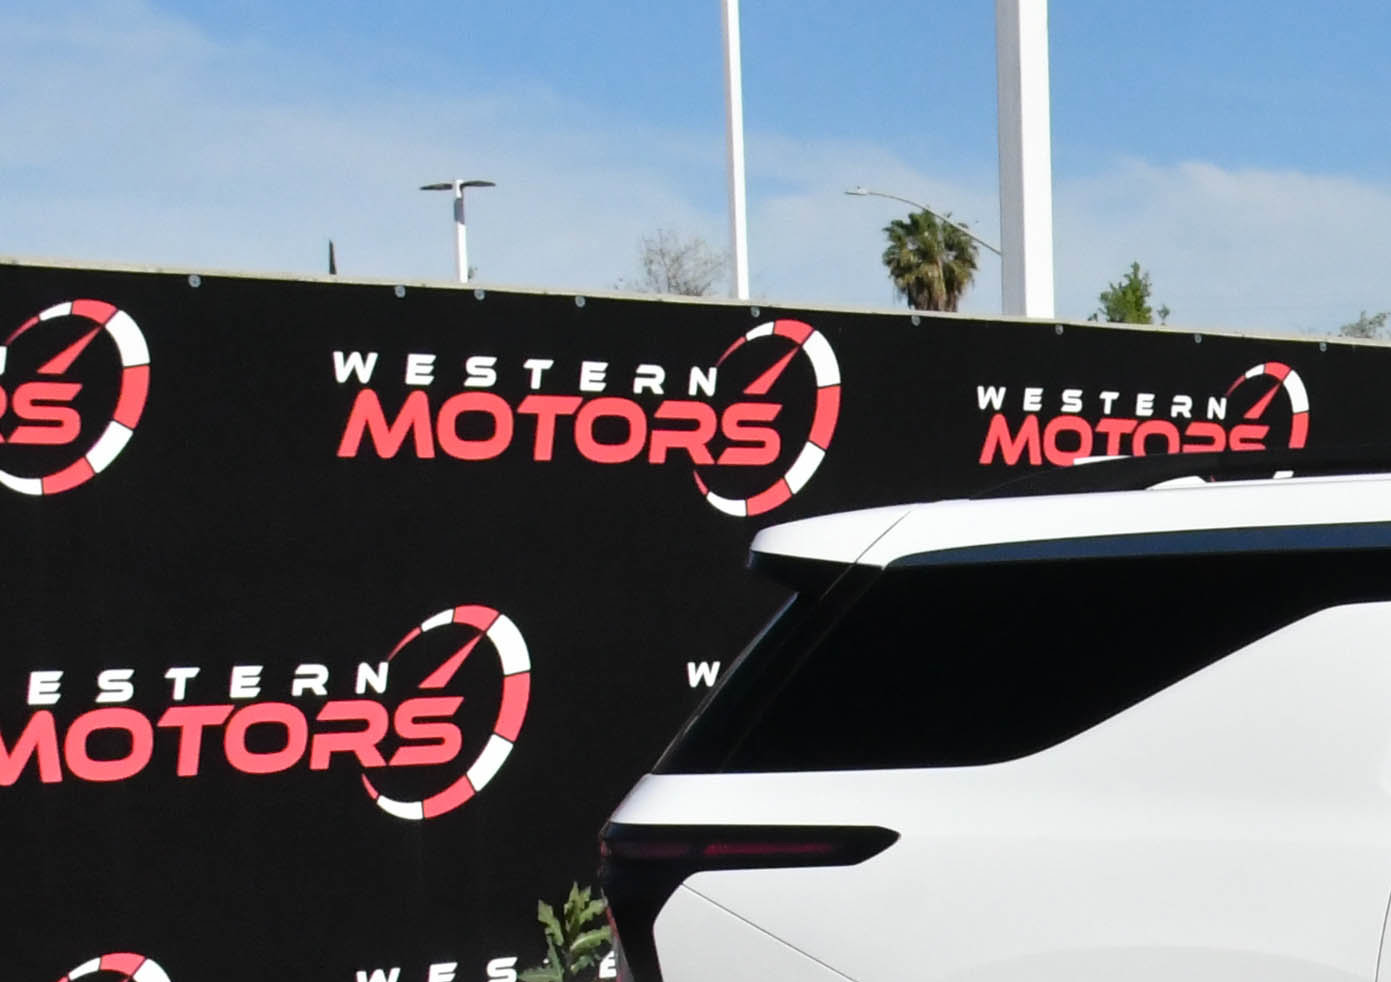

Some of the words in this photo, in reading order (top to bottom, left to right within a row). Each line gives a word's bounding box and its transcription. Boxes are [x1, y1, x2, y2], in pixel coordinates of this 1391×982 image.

[333, 350, 718, 397] WESTERN
[977, 385, 1227, 420] WESTERN
[0, 381, 83, 446] S
[337, 388, 783, 466] MOTORS
[0, 696, 464, 786] MOTORS
